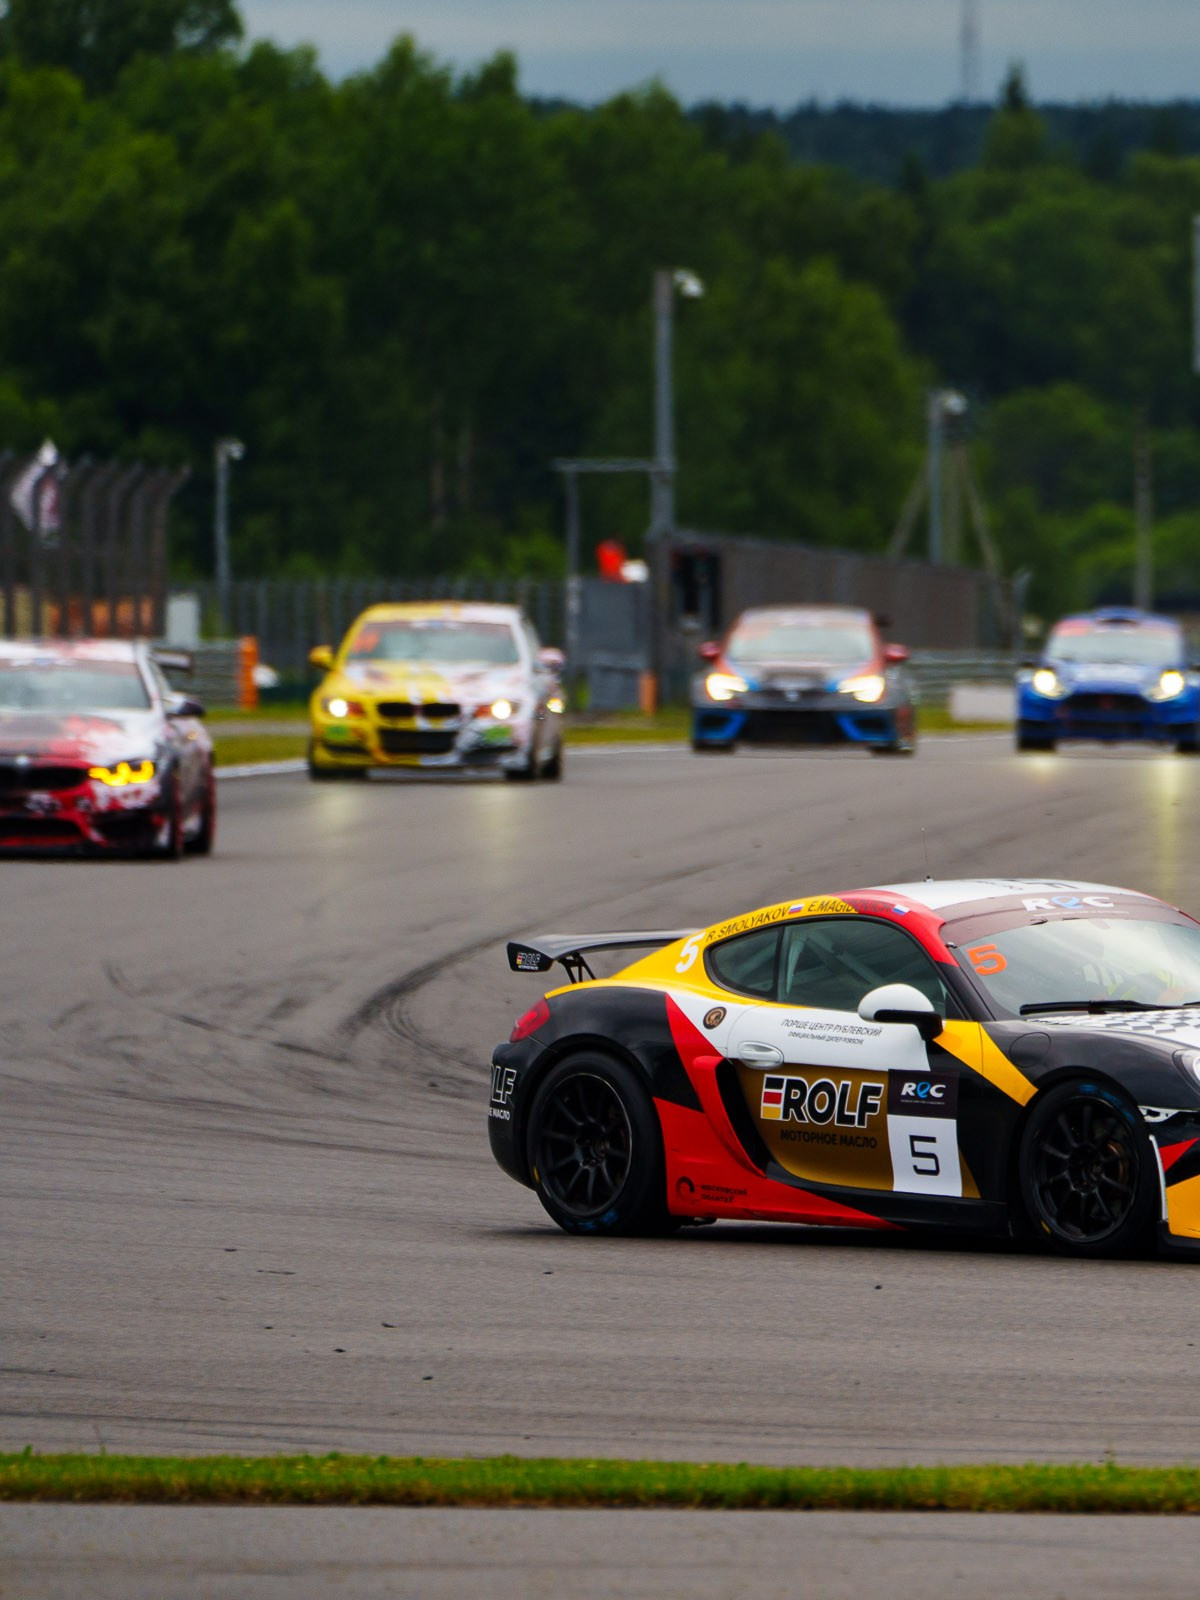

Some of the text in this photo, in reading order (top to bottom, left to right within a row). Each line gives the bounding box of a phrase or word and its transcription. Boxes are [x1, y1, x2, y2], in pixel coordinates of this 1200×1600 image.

[675, 931, 707, 974] 5
[966, 943, 1008, 976] 5
[782, 1019, 809, 1029] ПОРШЕ
[809, 1022, 834, 1032] ЦЕНТР
[491, 1064, 517, 1105] LF
[781, 1075, 885, 1128] ROLF
[780, 1128, 878, 1149] МОТОРНОЕ МАСЛО
[908, 1134, 940, 1176] 5
